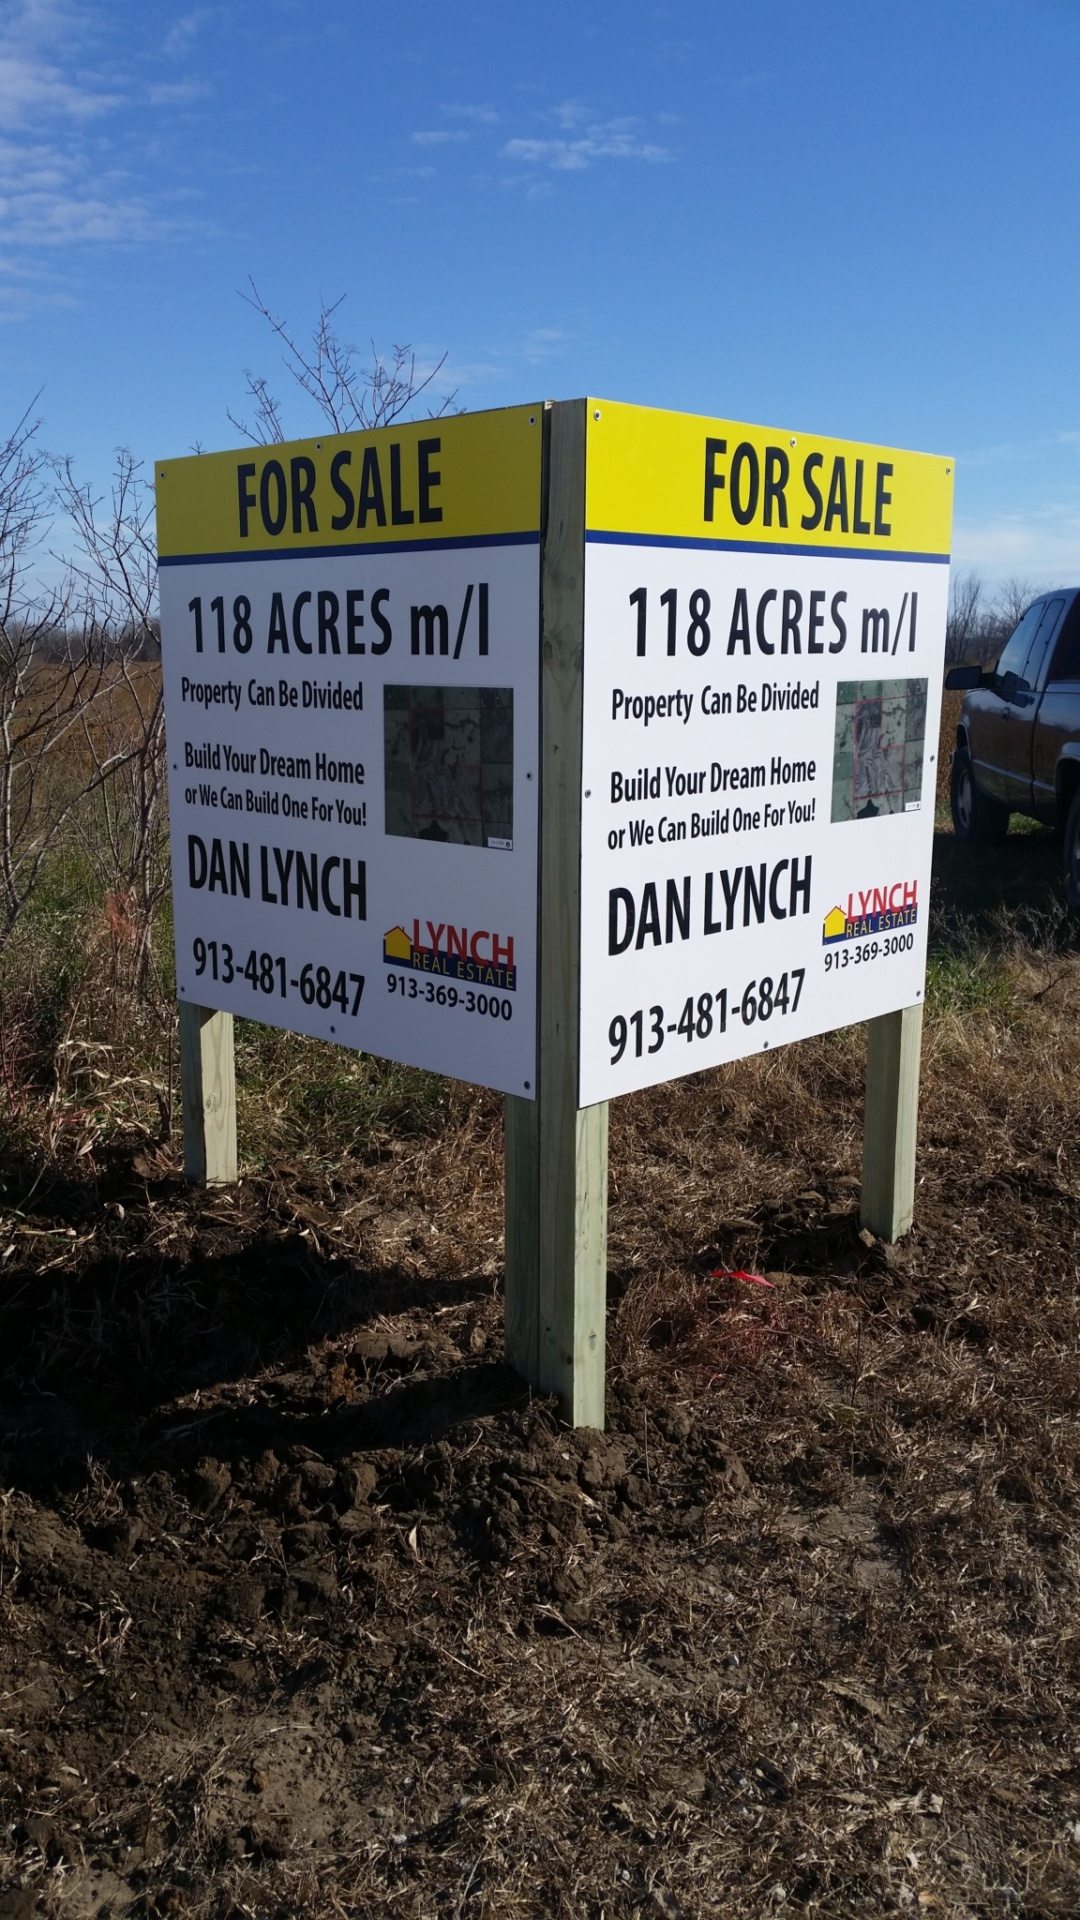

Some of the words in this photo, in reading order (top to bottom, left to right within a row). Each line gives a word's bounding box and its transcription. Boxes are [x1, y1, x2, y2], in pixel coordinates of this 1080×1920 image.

[237, 456, 318, 537] FOR
[330, 438, 443, 531] SALE
[703, 437, 789, 528] FOR
[800, 452, 894, 536] SALE
[188, 595, 253, 653] 118
[267, 588, 392, 655] ACRES
[410, 582, 489, 659] m/l
[629, 587, 711, 657] 118
[726, 587, 848, 656] ACRES
[861, 591, 918, 656] m/l
[181, 677, 242, 711] Property
[248, 679, 275, 706] Can
[279, 680, 298, 708] Be
[302, 681, 363, 710] Divided
[612, 687, 693, 726] Property
[701, 684, 732, 715] Can
[737, 683, 757, 713] Be
[761, 680, 819, 712] Divided
[184, 741, 220, 771] Build
[224, 745, 256, 774] Your
[259, 748, 311, 781] Dream
[316, 752, 365, 785] Home
[610, 766, 661, 803] Build
[665, 763, 706, 797] Your
[710, 760, 766, 791] Dream
[770, 756, 816, 786] Home
[185, 789, 198, 805] or
[199, 784, 218, 807] We
[220, 786, 243, 810] Can
[246, 790, 279, 816] Build
[282, 793, 308, 818] One
[312, 797, 333, 822] For
[335, 799, 367, 827] You!
[608, 828, 626, 850] or
[629, 820, 654, 847] We
[658, 816, 686, 843] Can
[691, 809, 730, 839] Build
[733, 807, 760, 833] One
[764, 803, 787, 828] For
[787, 798, 816, 824] You!
[188, 834, 250, 899] DAN
[260, 845, 367, 921] LYNCH
[847, 880, 918, 923] LYNCH
[608, 876, 691, 956] DAN
[703, 855, 812, 936] LYNCH
[846, 921, 874, 938] REAL
[878, 908, 917, 931] ESTATE
[413, 919, 514, 971] LYNCH
[413, 951, 450, 975] REAL
[456, 956, 514, 989] ESTATE
[824, 933, 913, 972] 913-369-3000
[193, 937, 365, 1017] 913-481-6847
[386, 973, 513, 1021] 913-369-3000
[609, 968, 805, 1066] 913-481-6847
